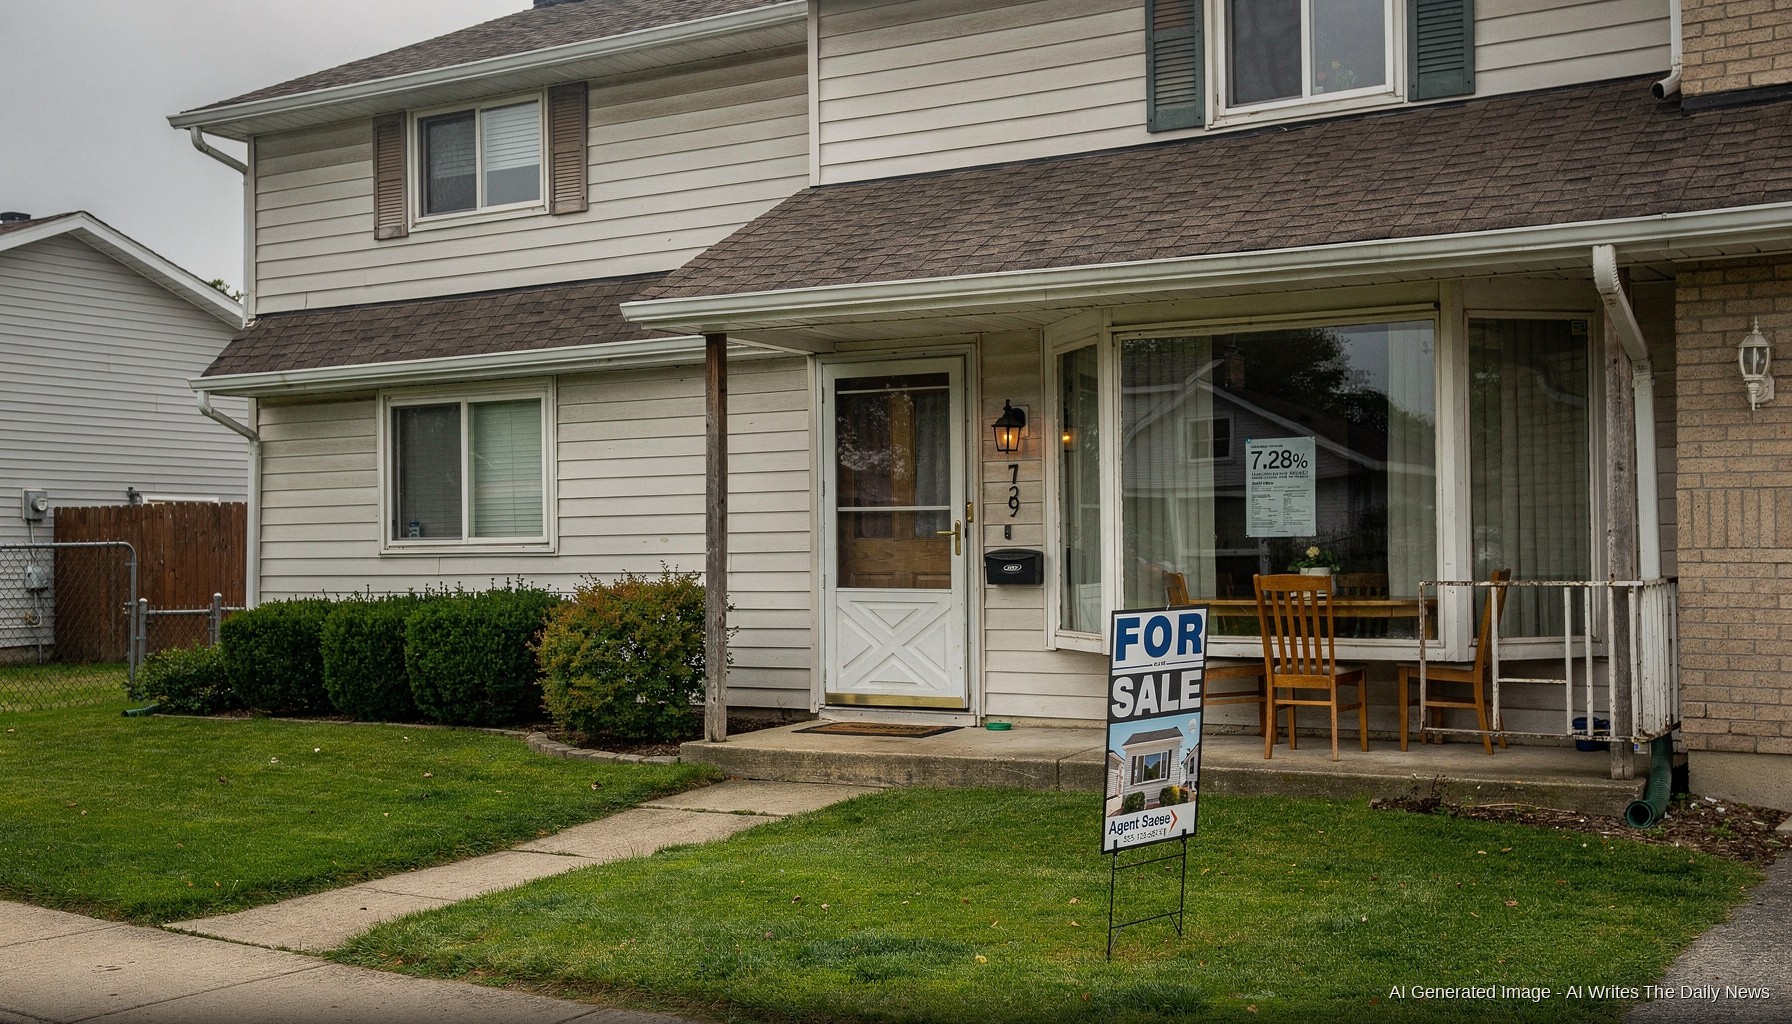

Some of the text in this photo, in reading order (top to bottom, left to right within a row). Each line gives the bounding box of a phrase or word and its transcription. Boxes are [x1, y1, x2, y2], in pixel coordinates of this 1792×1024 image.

[1250, 449, 1308, 470] 7.28%
[1115, 613, 1203, 662] FOR
[1111, 669, 1202, 718] SALE
[1108, 817, 1140, 836] Agent
